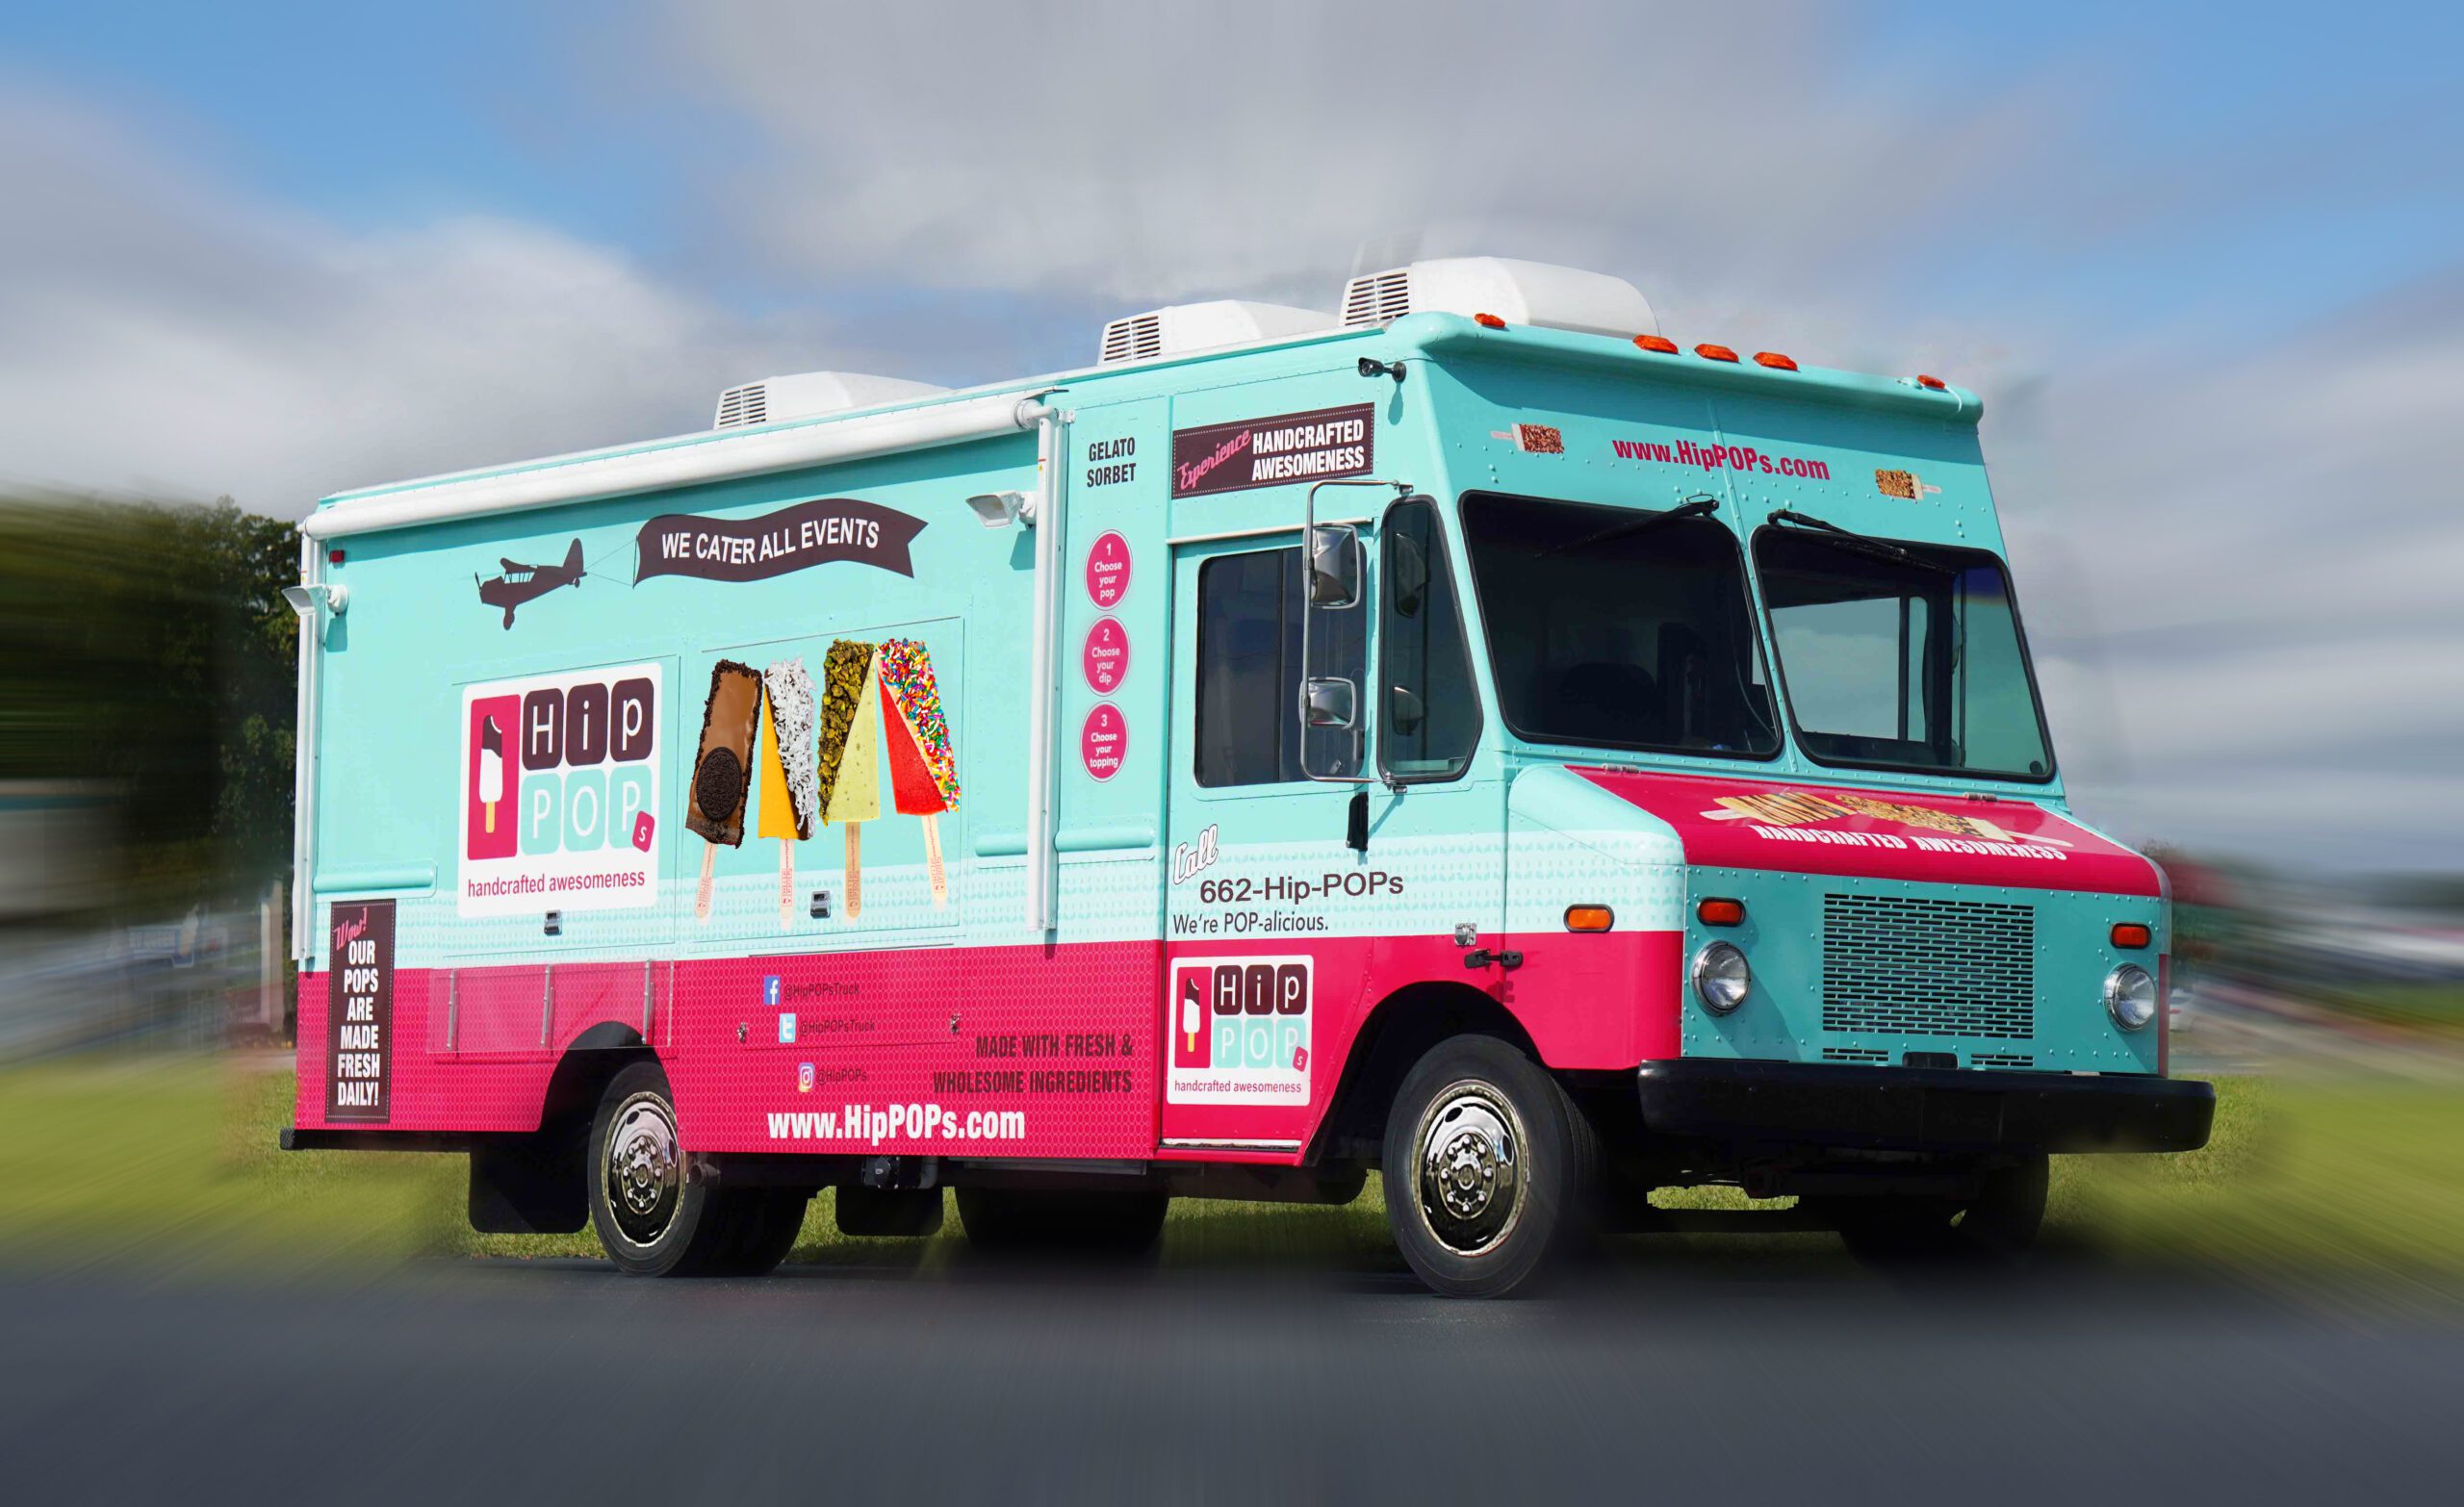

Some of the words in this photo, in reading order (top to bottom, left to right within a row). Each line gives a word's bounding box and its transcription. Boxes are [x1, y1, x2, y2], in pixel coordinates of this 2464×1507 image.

[1252, 419, 1364, 454] HANDCRAFTED
[1089, 437, 1135, 462] GELATO
[1176, 429, 1251, 490] Experience
[1612, 439, 1831, 480] www.HipPOPs.com
[1087, 463, 1136, 487] SORBET
[1252, 446, 1365, 482] AWESOMENESS
[662, 532, 691, 559] WE
[696, 533, 756, 565] CATER
[758, 528, 796, 562] ALL
[801, 518, 880, 549] EVENTS
[1106, 543, 1112, 555] 1
[1094, 561, 1122, 573] Choose
[1099, 575, 1117, 588] your
[1100, 588, 1115, 600] pop
[1103, 628, 1109, 641] 2
[1091, 646, 1120, 658] Choose
[1096, 660, 1115, 674] your
[1098, 673, 1112, 686] dip
[531, 698, 642, 755] Hip
[1101, 714, 1108, 727] 3
[1091, 731, 1117, 743] Choose
[1090, 756, 1118, 769] topping
[1095, 745, 1113, 757] your
[1747, 824, 1909, 850] HANDCRAFTED
[1910, 835, 2067, 860] AWESOMENESS
[1172, 824, 1219, 885] Call
[468, 874, 545, 898] handcrafted
[549, 870, 645, 891] awesomeness
[1199, 871, 1404, 905] 662-Hip-POPs
[333, 907, 368, 952] Wow!
[1173, 913, 1219, 934] We're
[1223, 910, 1328, 933] POP-alicious.
[348, 940, 375, 965] OUR
[344, 968, 379, 993] POPS
[784, 982, 860, 1001] @HipPOPsTruck
[1219, 974, 1299, 1009] Hip
[346, 997, 373, 1021] ARE
[341, 1025, 379, 1050] MADE
[800, 1018, 875, 1037] @HipPOPsTruck
[976, 1035, 1017, 1058] MADE
[1022, 1034, 1059, 1058] WITH
[1065, 1034, 1116, 1057] FRESH
[1121, 1034, 1133, 1057] &
[337, 1053, 380, 1078] FRESH
[816, 1068, 867, 1086] @HipPOPs
[933, 1071, 1024, 1093] WHOLESOME
[1029, 1069, 1132, 1093] INGREDIENTS
[1174, 1080, 1231, 1092] handcrafted
[1233, 1082, 1301, 1093] awesomeness
[337, 1081, 379, 1107] DAILY!
[767, 1104, 1025, 1146] www.HipPOPs.com
